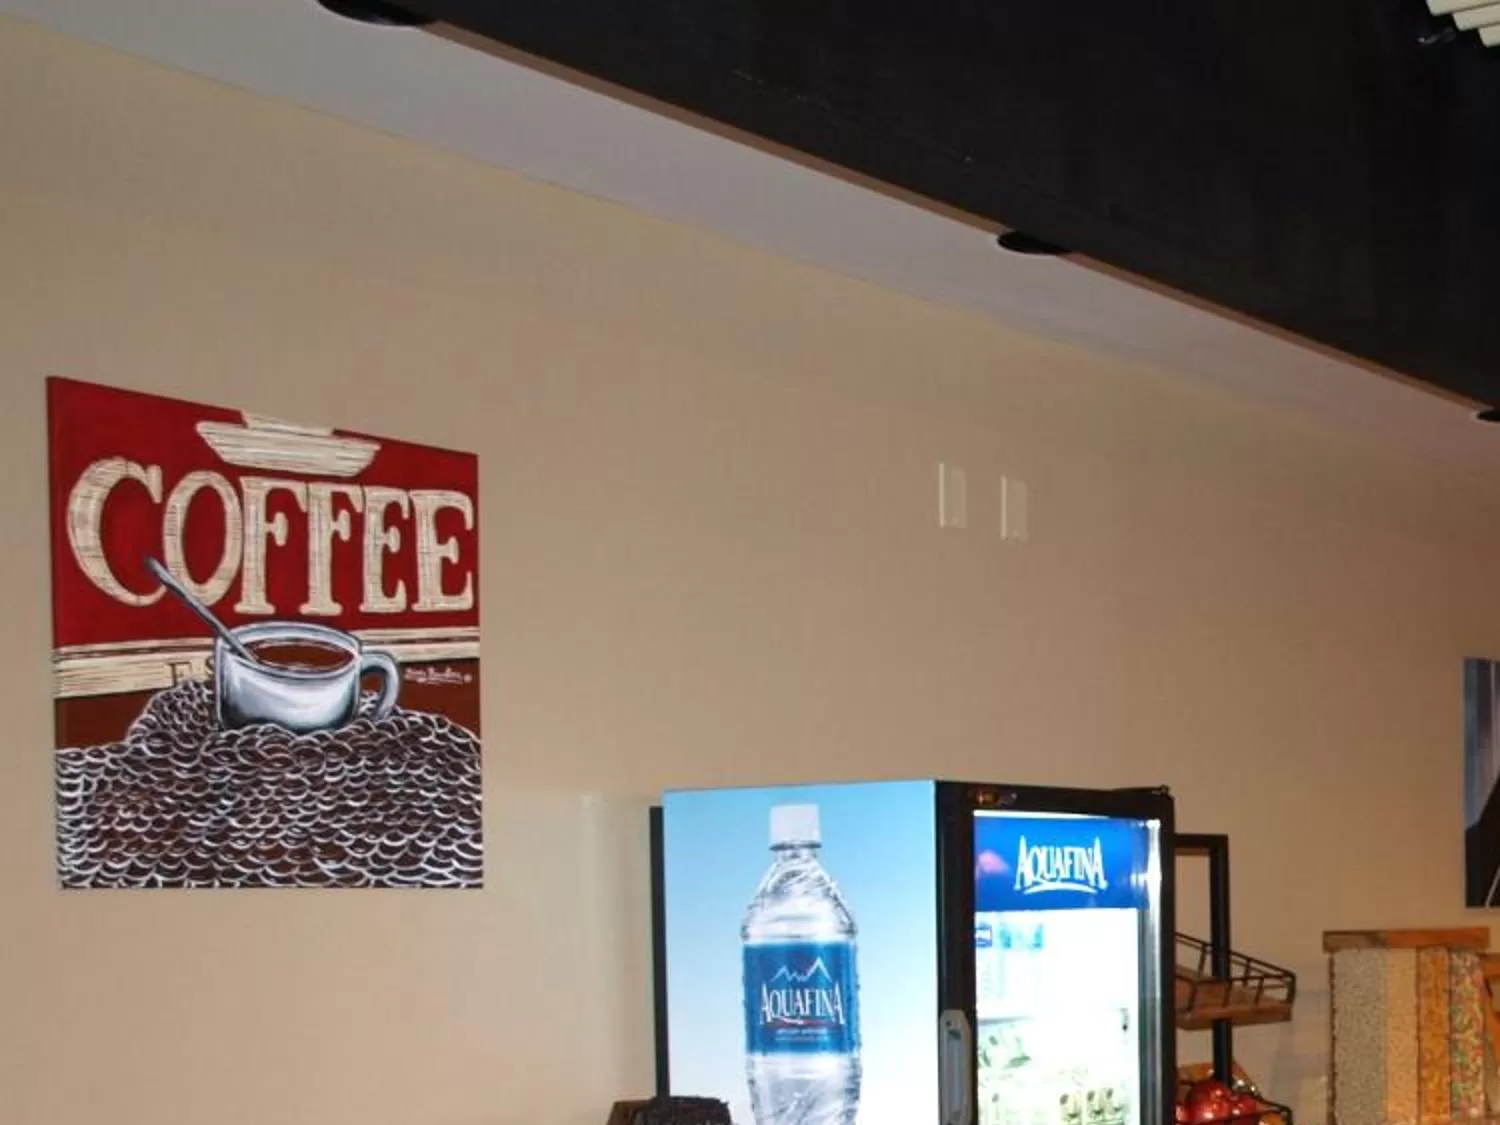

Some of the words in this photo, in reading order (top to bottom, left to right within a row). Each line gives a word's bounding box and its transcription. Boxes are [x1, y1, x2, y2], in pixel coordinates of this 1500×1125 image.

[67, 456, 474, 616] COFFEE
[1014, 834, 1108, 891] AQUAFINA
[759, 981, 846, 1025] AQUAFINA
